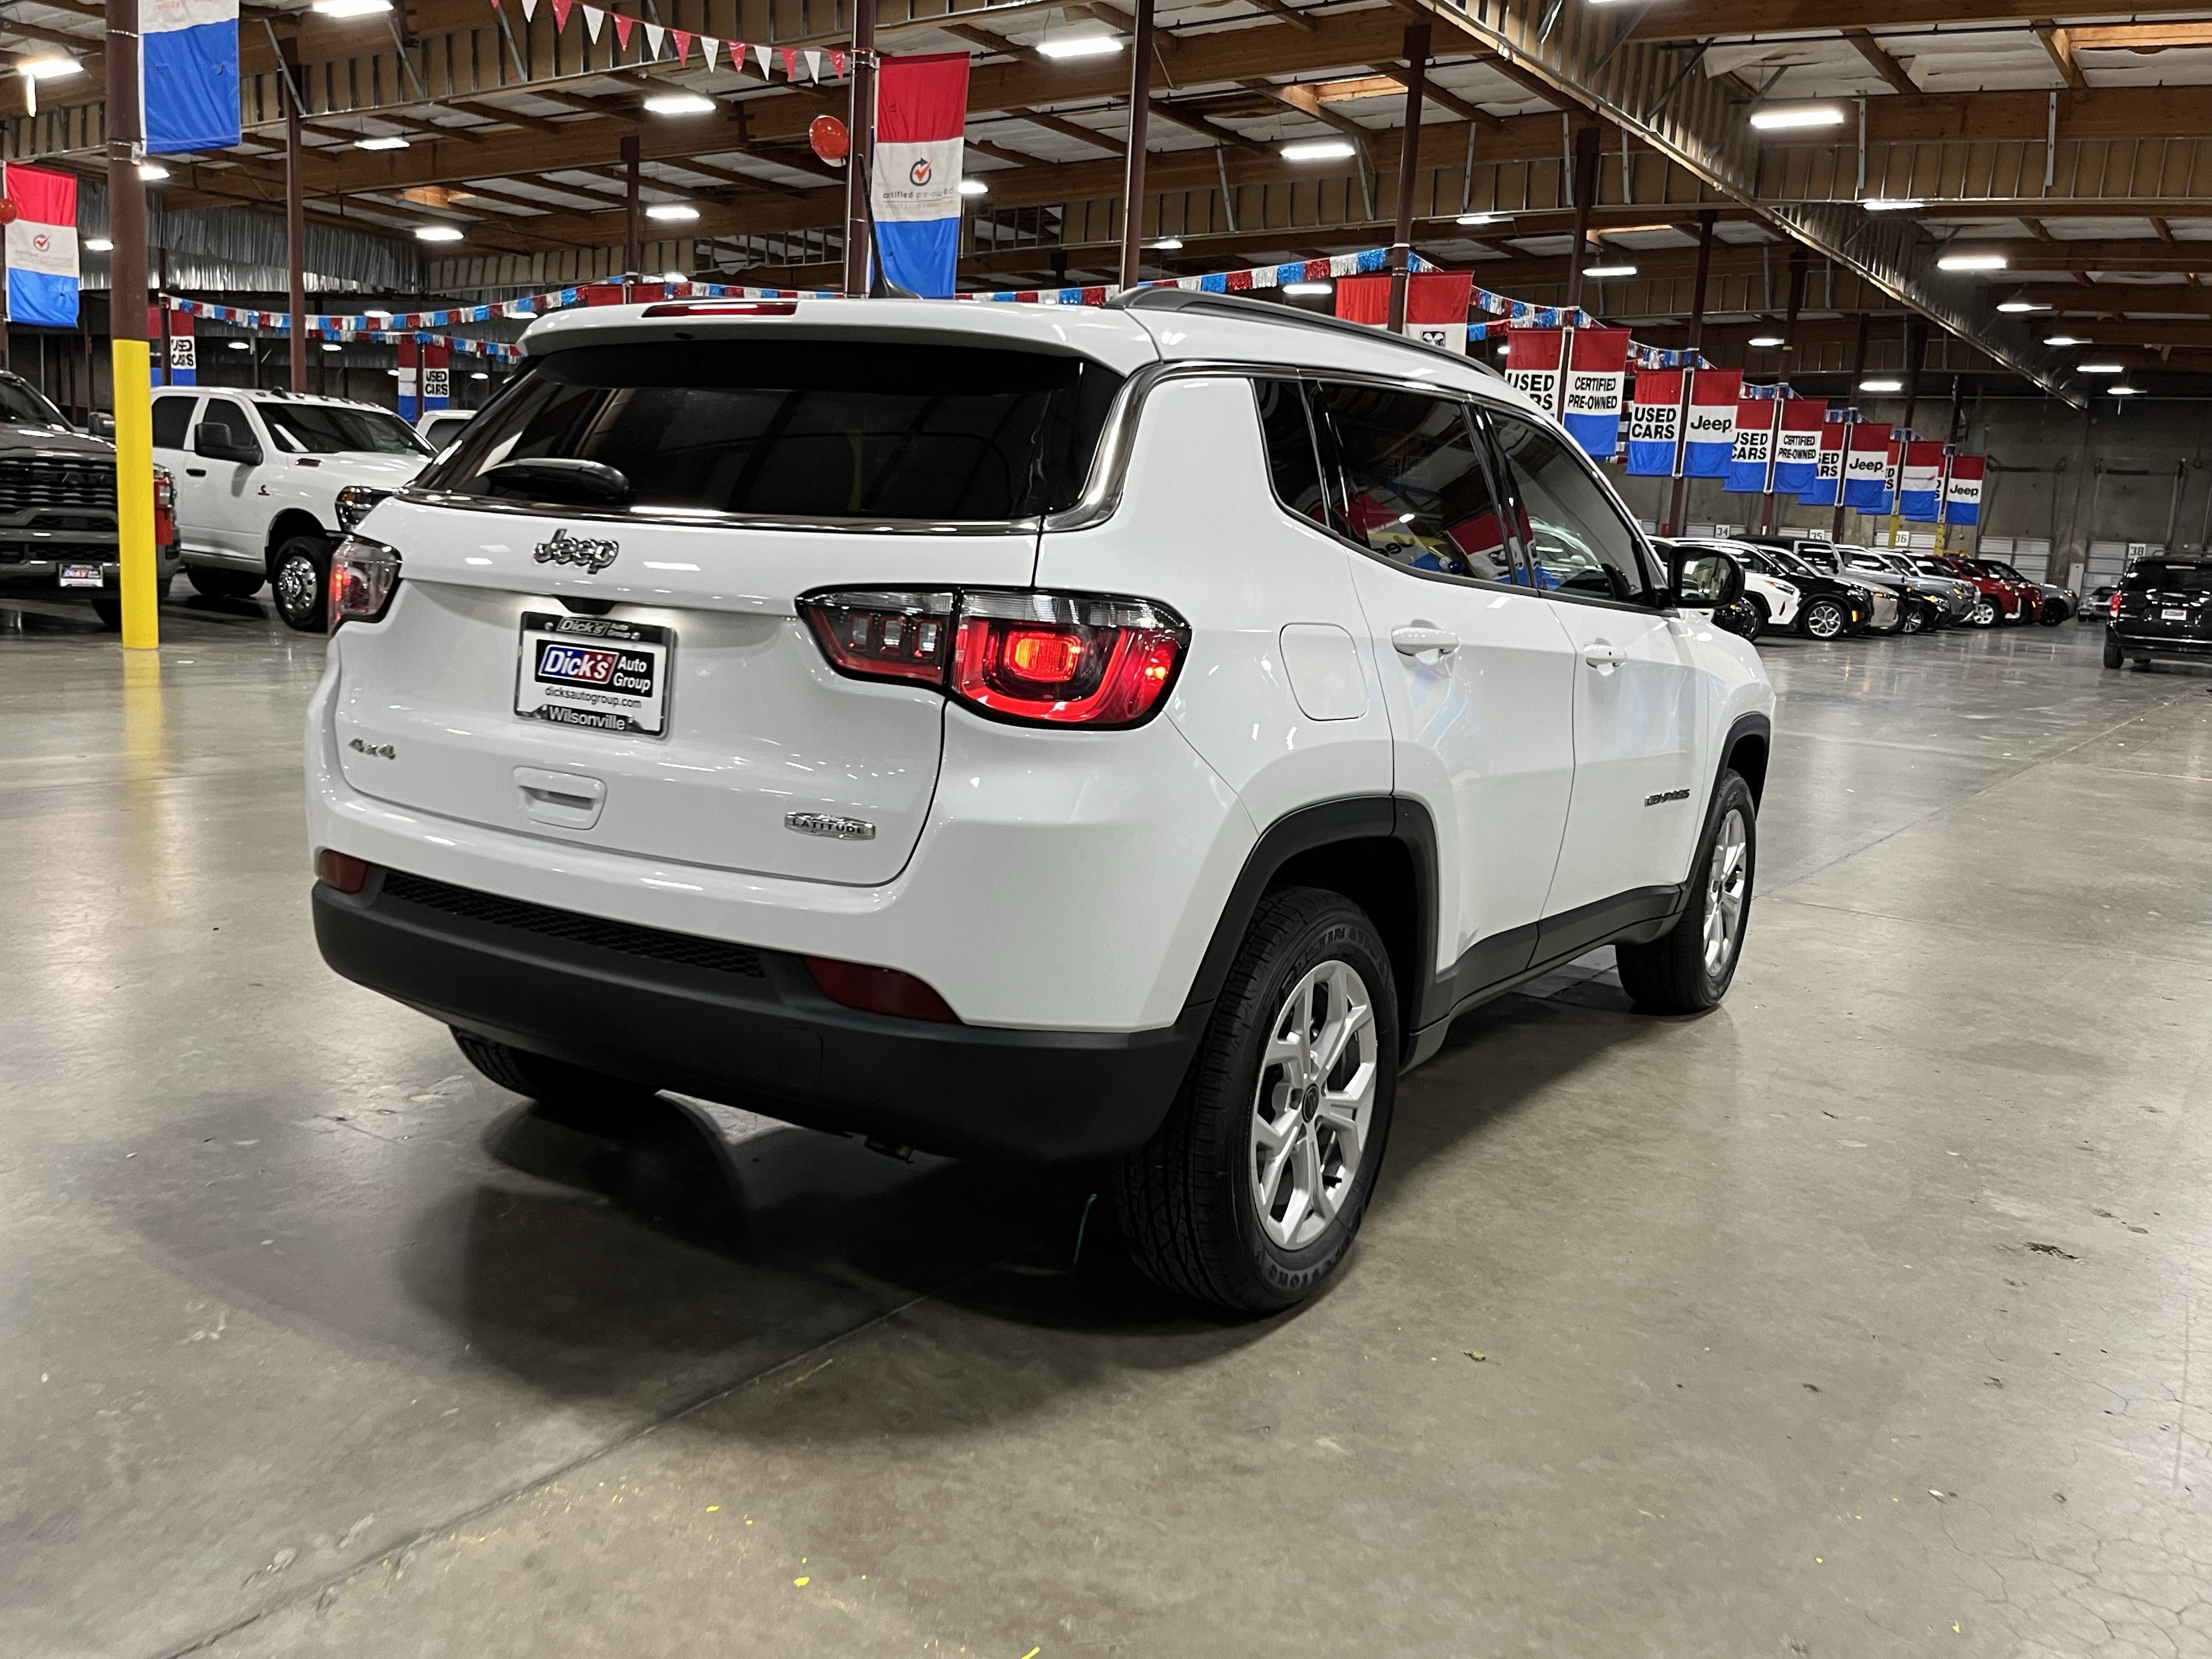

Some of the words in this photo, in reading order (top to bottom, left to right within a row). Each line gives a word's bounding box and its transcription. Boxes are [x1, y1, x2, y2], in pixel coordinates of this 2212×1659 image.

[916, 188, 953, 199] pre-owed
[426, 371, 447, 382] USED
[1508, 373, 1554, 391] USED
[1575, 377, 1616, 391] CERTIFIED
[1530, 394, 1553, 410] RS
[1568, 394, 1617, 410] PRE-OWNED
[1634, 407, 1677, 422] USED
[1632, 424, 1675, 439] CARS
[1690, 415, 1732, 433] Jeep
[1784, 435, 1815, 445] CERTIFIED
[1778, 448, 1816, 459] PRE-OWNED
[1819, 453, 1839, 464] ED
[1817, 466, 1838, 476] RS
[1849, 458, 1883, 472] Jeep
[1950, 485, 1979, 497] Jeep
[1717, 527, 1728, 537] 34
[533, 528, 619, 574] Jeep
[2130, 546, 2144, 556] 38
[561, 620, 603, 634] Dick's
[544, 651, 609, 679] Dick's
[617, 656, 647, 673] Auto
[613, 672, 651, 693] Group
[545, 686, 642, 708] dicksautogroup.com
[549, 706, 625, 730] Wilsonville
[792, 819, 865, 834] LATITUDE
